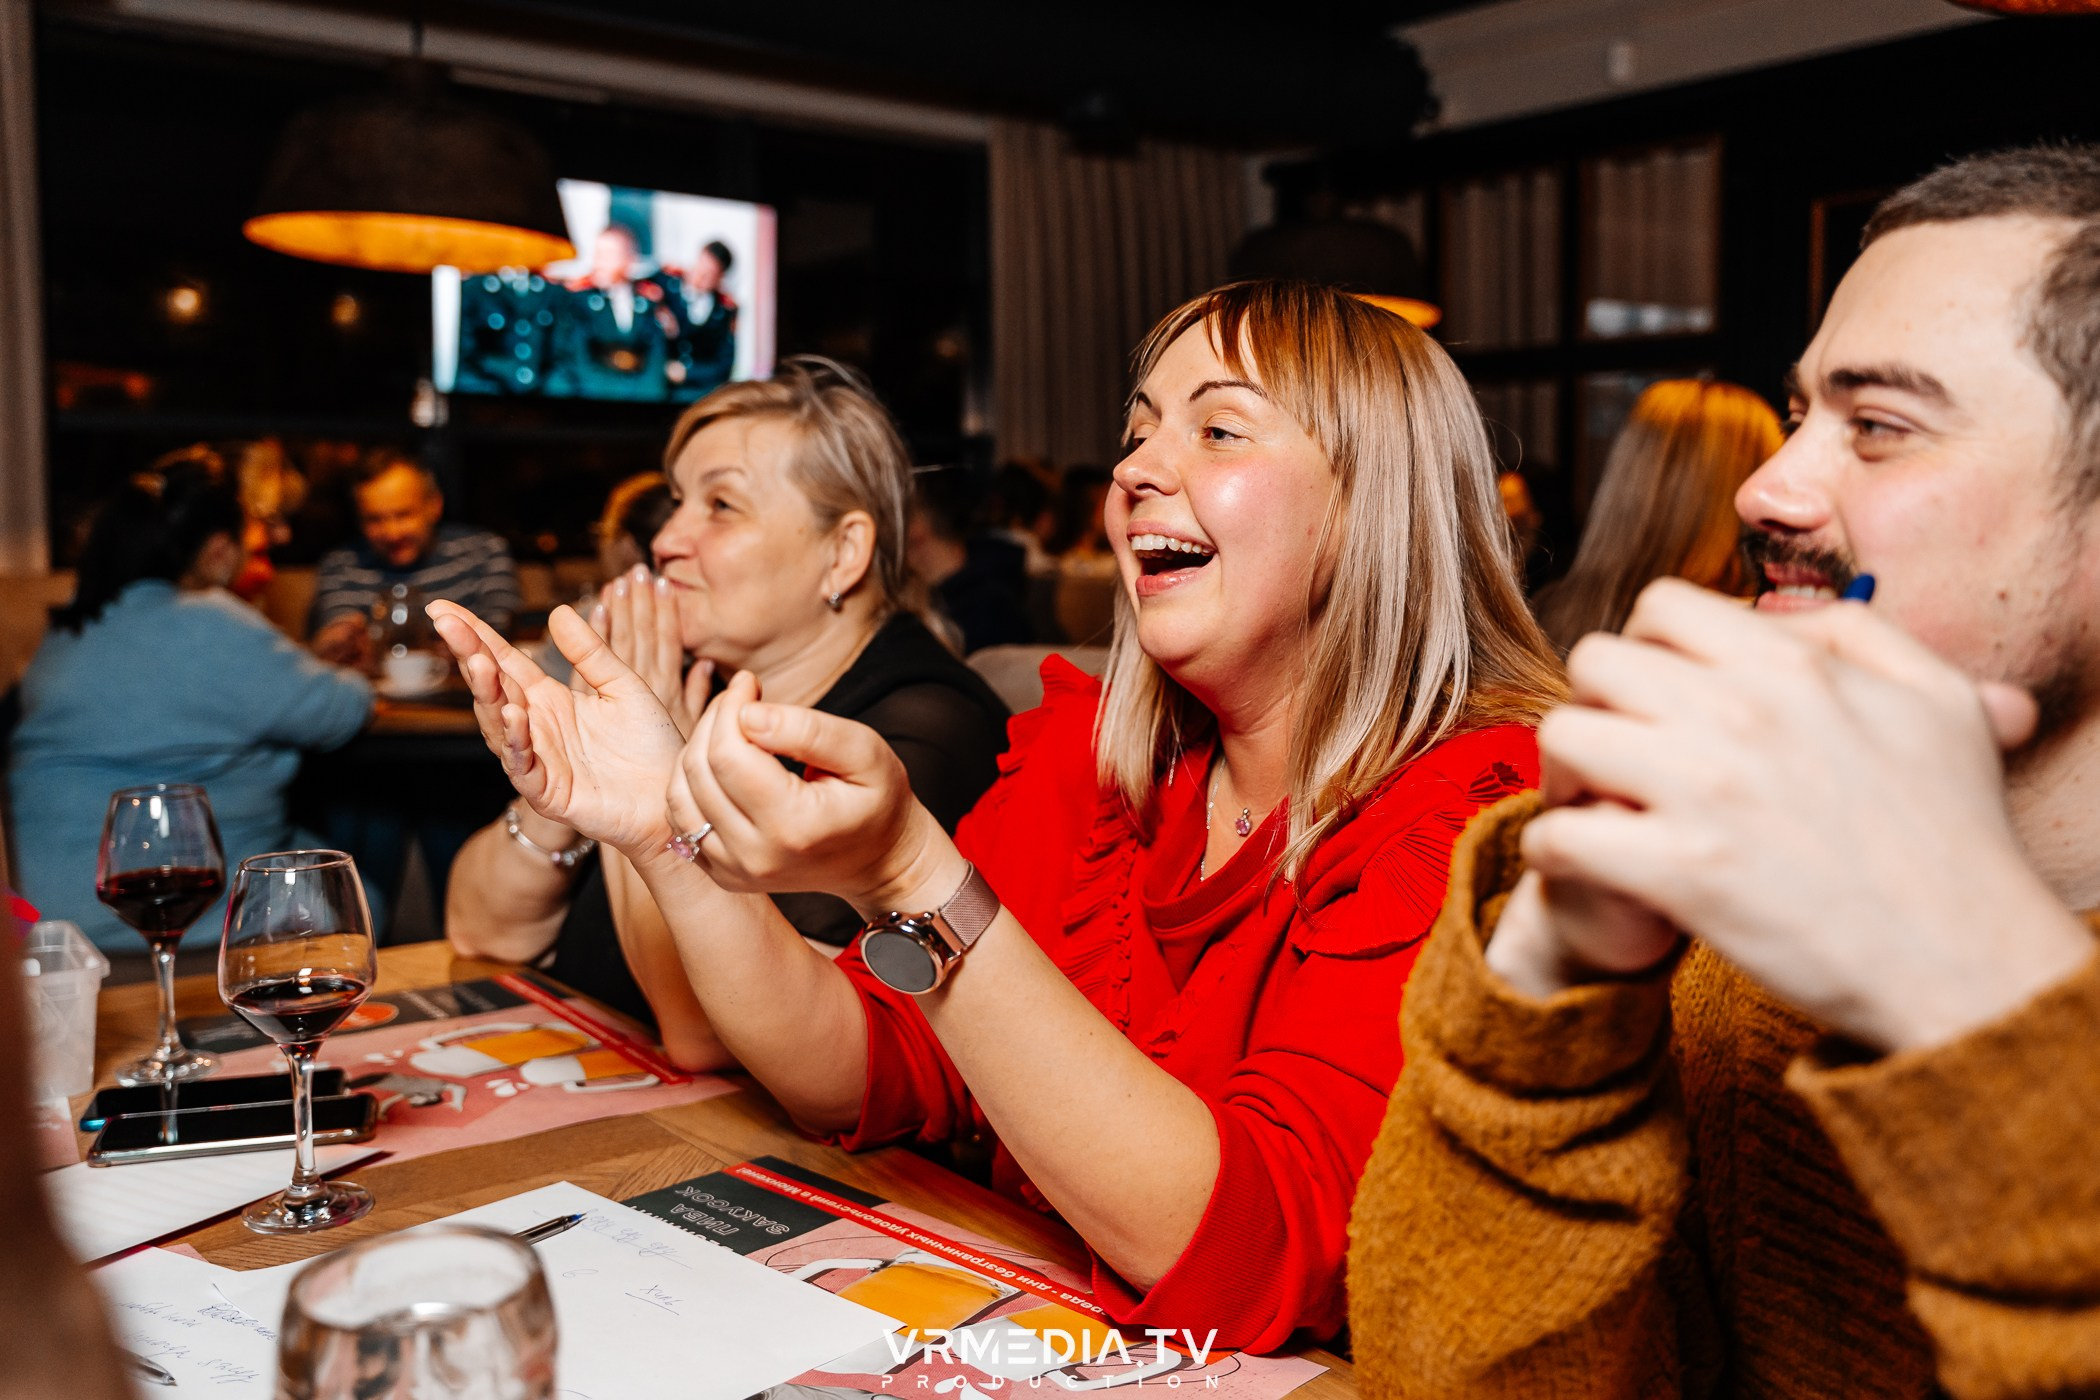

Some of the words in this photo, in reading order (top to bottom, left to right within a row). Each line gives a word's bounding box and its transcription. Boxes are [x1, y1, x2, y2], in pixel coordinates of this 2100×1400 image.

[670, 1203, 740, 1236] ПИВА
[675, 1185, 790, 1235] ЗАКУСОК
[809, 1192, 910, 1235] удовольствий
[906, 1231, 1017, 1278] безграничных
[1016, 1275, 1053, 1291] дни
